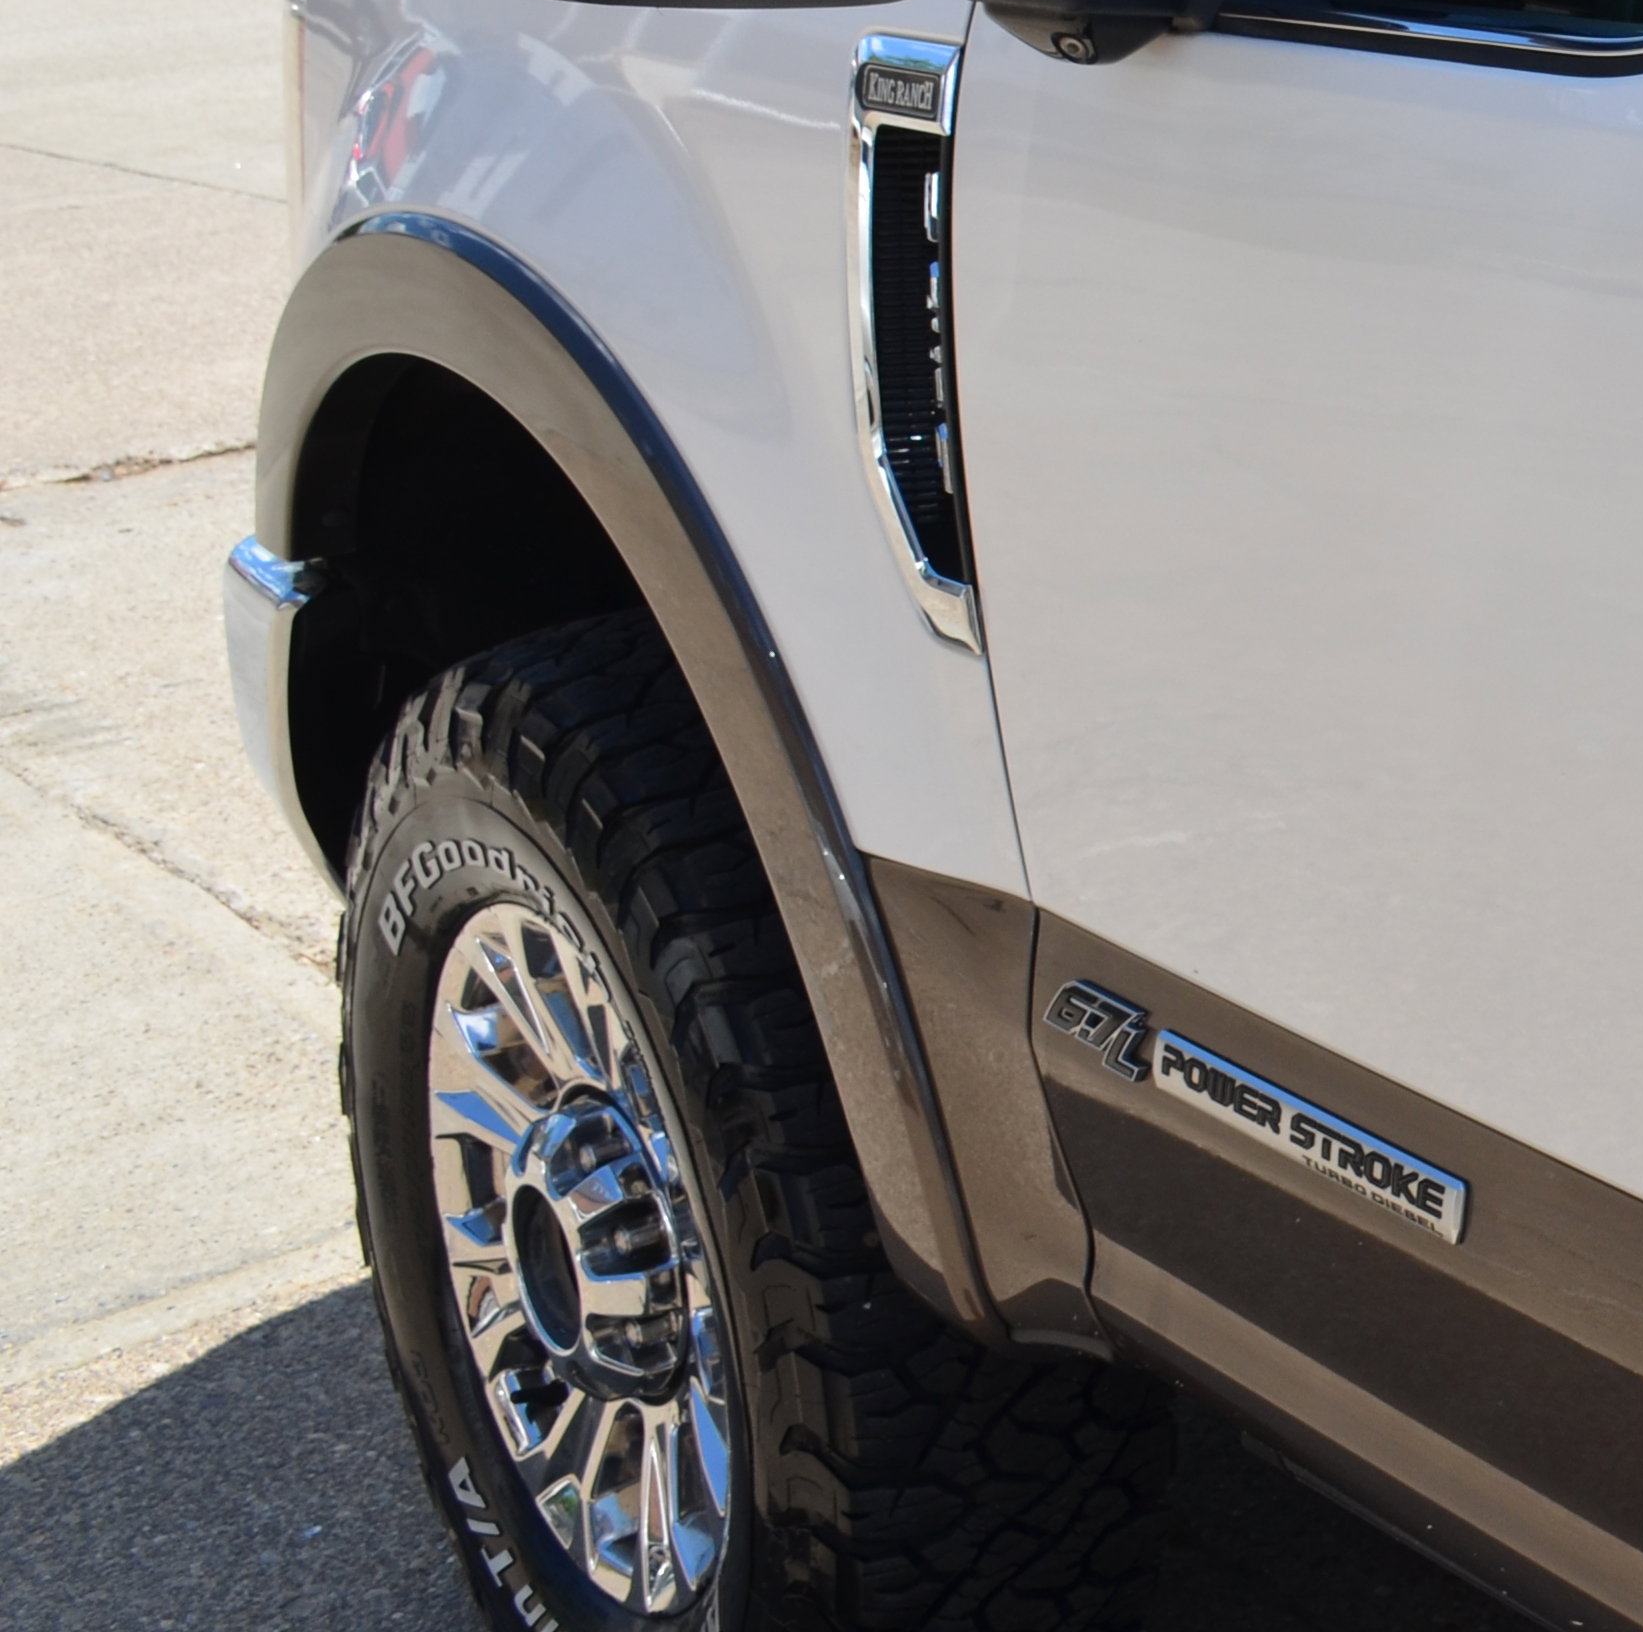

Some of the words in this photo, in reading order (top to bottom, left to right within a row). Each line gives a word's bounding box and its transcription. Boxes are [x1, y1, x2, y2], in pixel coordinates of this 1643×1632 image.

[868, 72, 895, 104] KING
[895, 80, 934, 110] RANCH
[1161, 1044, 1282, 1135] POWER
[1290, 1112, 1446, 1219] STROKE
[1302, 1154, 1367, 1198] TURBO
[1370, 1192, 1445, 1238] DIESEL
